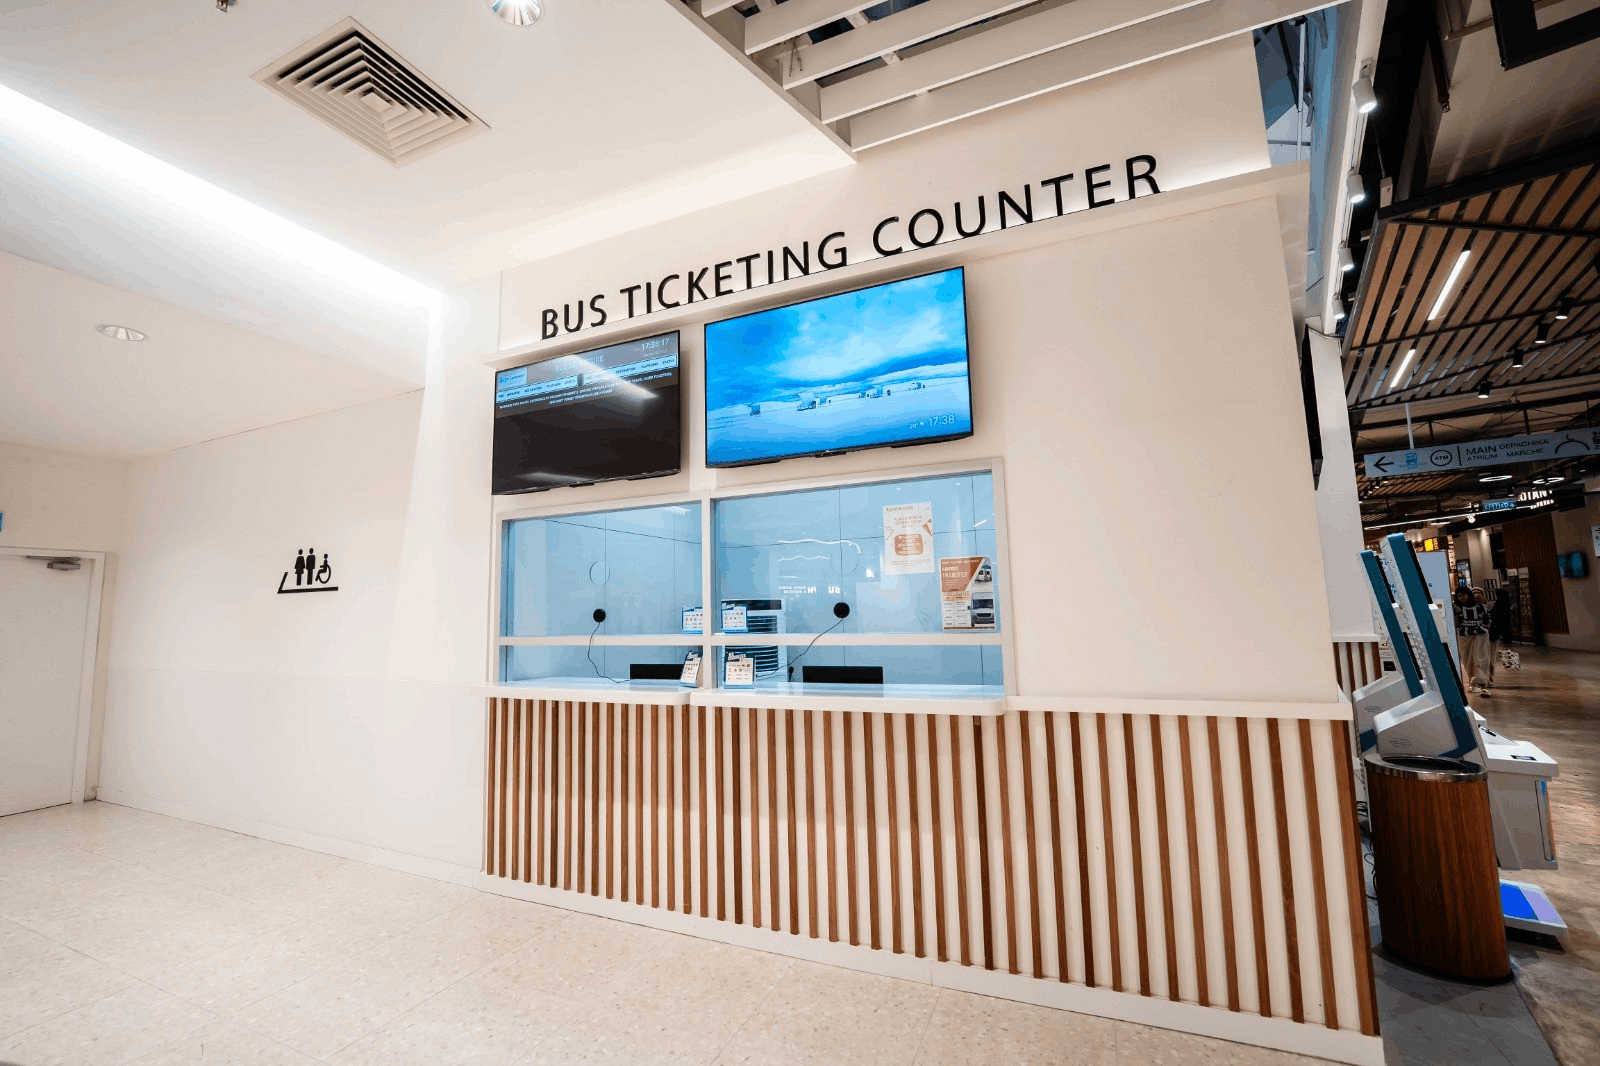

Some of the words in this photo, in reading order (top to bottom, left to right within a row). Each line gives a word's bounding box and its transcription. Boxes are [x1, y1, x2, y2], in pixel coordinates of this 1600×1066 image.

[542, 294, 607, 340] BUS
[619, 231, 847, 319] TICKETING
[872, 154, 1161, 258] COUNTER
[928, 414, 955, 427] 17:38
[1499, 439, 1549, 450] DEPACHIKA
[1465, 445, 1497, 456] MAIN
[1506, 447, 1545, 458] MARCHE
[1466, 453, 1498, 462] ATRIUM
[942, 571, 969, 579] TRANSFER
